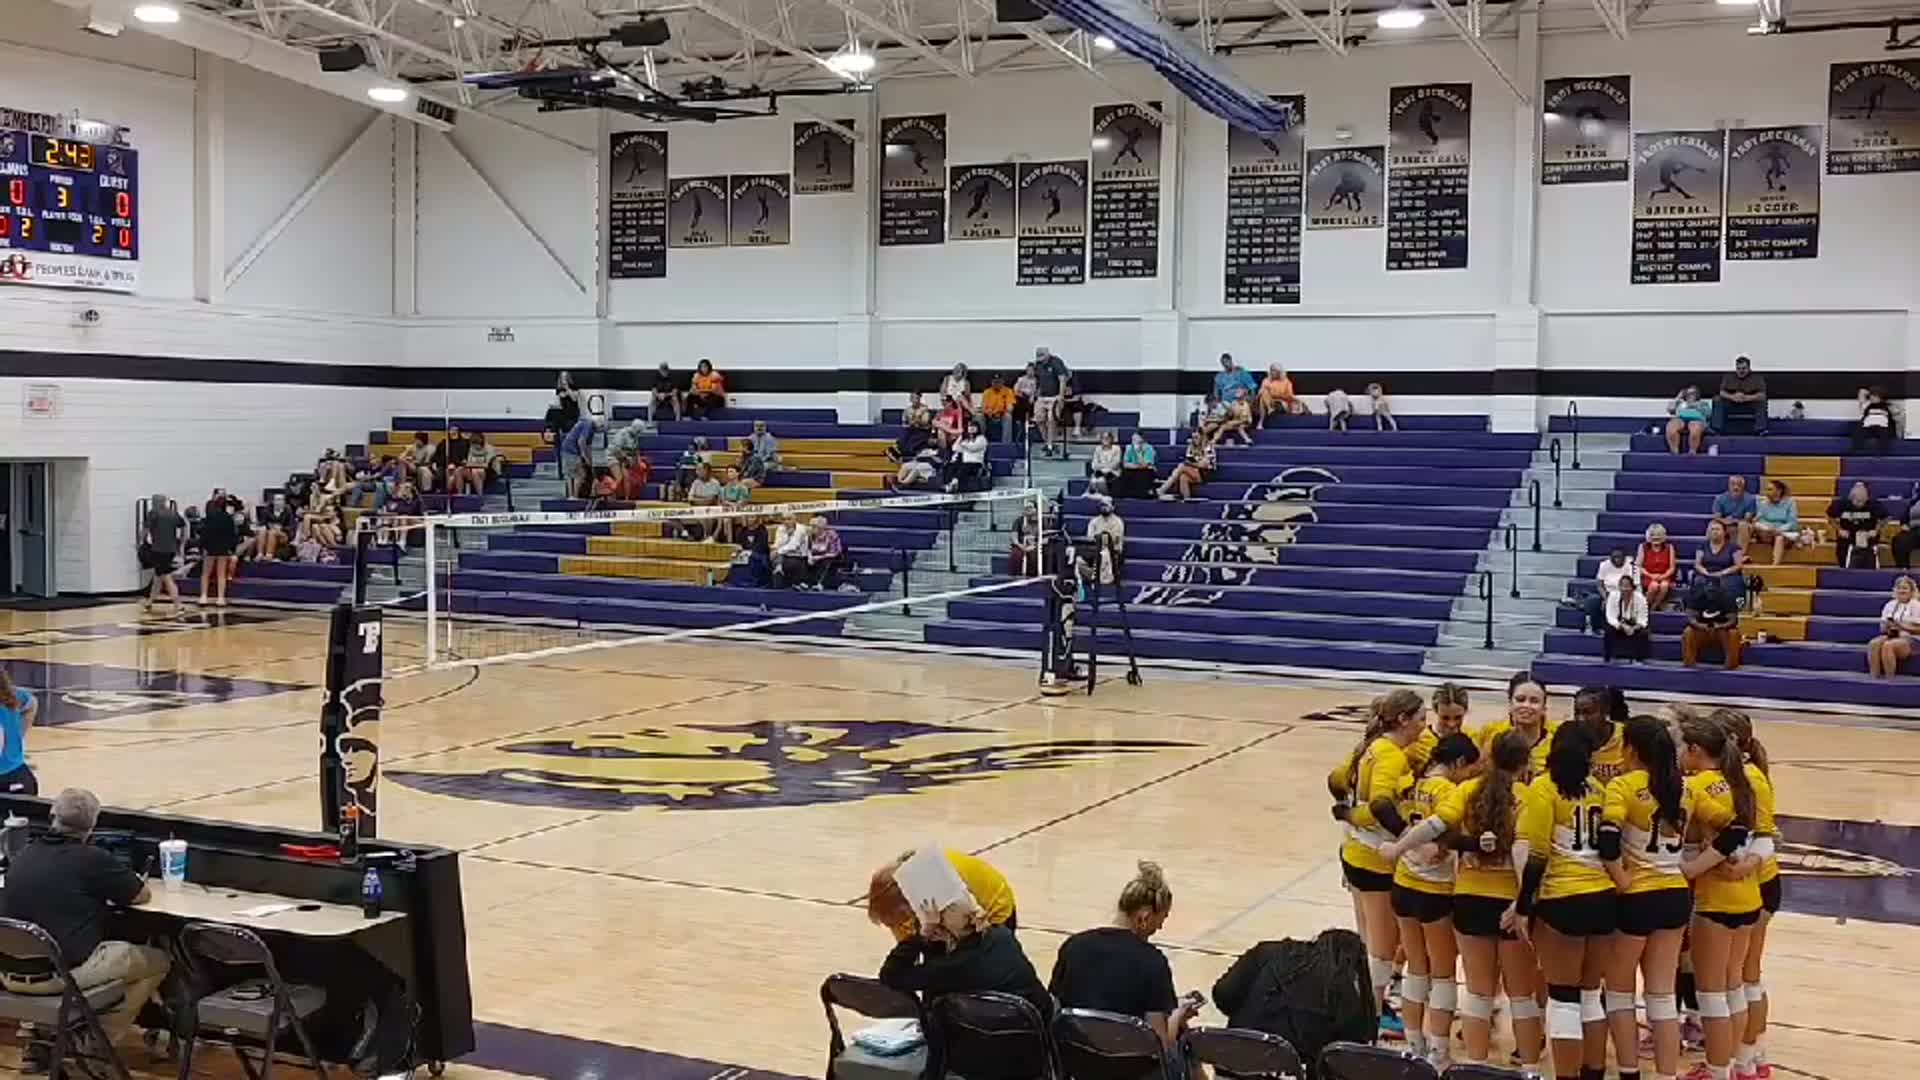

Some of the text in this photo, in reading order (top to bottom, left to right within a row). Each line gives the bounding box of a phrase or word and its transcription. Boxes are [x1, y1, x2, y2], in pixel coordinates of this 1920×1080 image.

[46, 138, 92, 168] 2:43
[9, 179, 24, 205] 0
[99, 174, 129, 189] GUEST
[56, 186, 67, 208] 3
[115, 191, 130, 218] 0
[21, 217, 31, 237] 2
[92, 226, 103, 244] 2
[119, 229, 129, 249] 0
